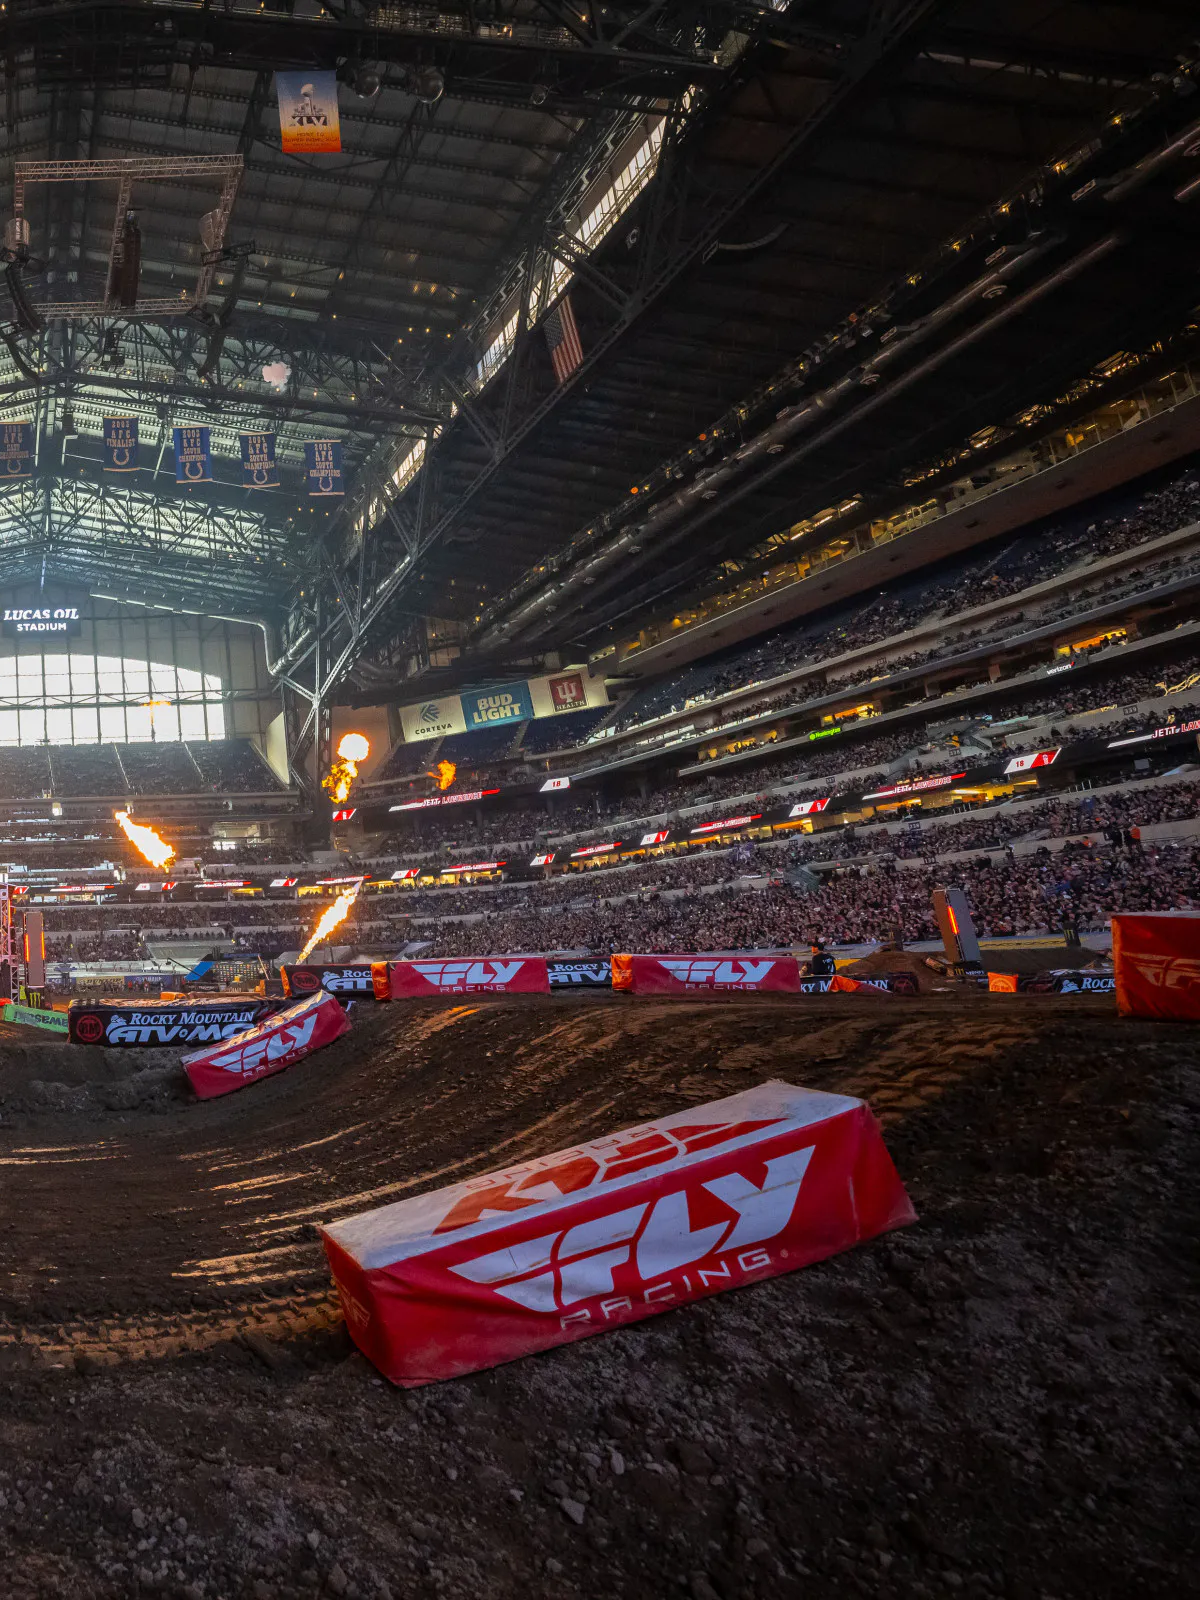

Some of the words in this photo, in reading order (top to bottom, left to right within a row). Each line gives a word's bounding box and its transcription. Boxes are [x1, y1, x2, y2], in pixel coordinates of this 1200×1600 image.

[111, 430, 131, 439] AFC
[182, 430, 200, 438] 2003
[107, 438, 136, 447] FINALIST
[183, 439, 200, 447] AFC
[248, 443, 268, 454] AFC
[179, 454, 206, 462] CHAMPIONS
[250, 454, 267, 462] SOUTH
[315, 450, 332, 461] AFC
[244, 461, 274, 469] CHAMPIONS
[310, 469, 340, 477] CHAMPIONS
[4, 609, 50, 620] LUCAS
[54, 608, 79, 620] OIL
[17, 623, 66, 631] STADIUM
[1046, 663, 1072, 675] verizon
[477, 693, 513, 709] BUD
[556, 701, 586, 711] HEALTH
[472, 703, 521, 724] LIGHT
[414, 723, 453, 735] CORTEVA
[1152, 726, 1176, 739] JETT
[1015, 760, 1025, 768] 18
[892, 785, 912, 794] JETT
[912, 776, 952, 791] LAWRENCE
[426, 961, 526, 985] FLY
[553, 963, 598, 972] ROCKY
[672, 961, 776, 983] FLY
[342, 970, 372, 978] ROC
[1081, 977, 1116, 989] ROCK
[440, 985, 506, 993] RACING
[130, 1012, 177, 1025] ROCKY
[177, 1011, 255, 1024] MOUNTAIN
[226, 1013, 318, 1072] FLY
[243, 1047, 309, 1078] RACING
[500, 1145, 815, 1312] FLY
[559, 1247, 771, 1331] RACING
